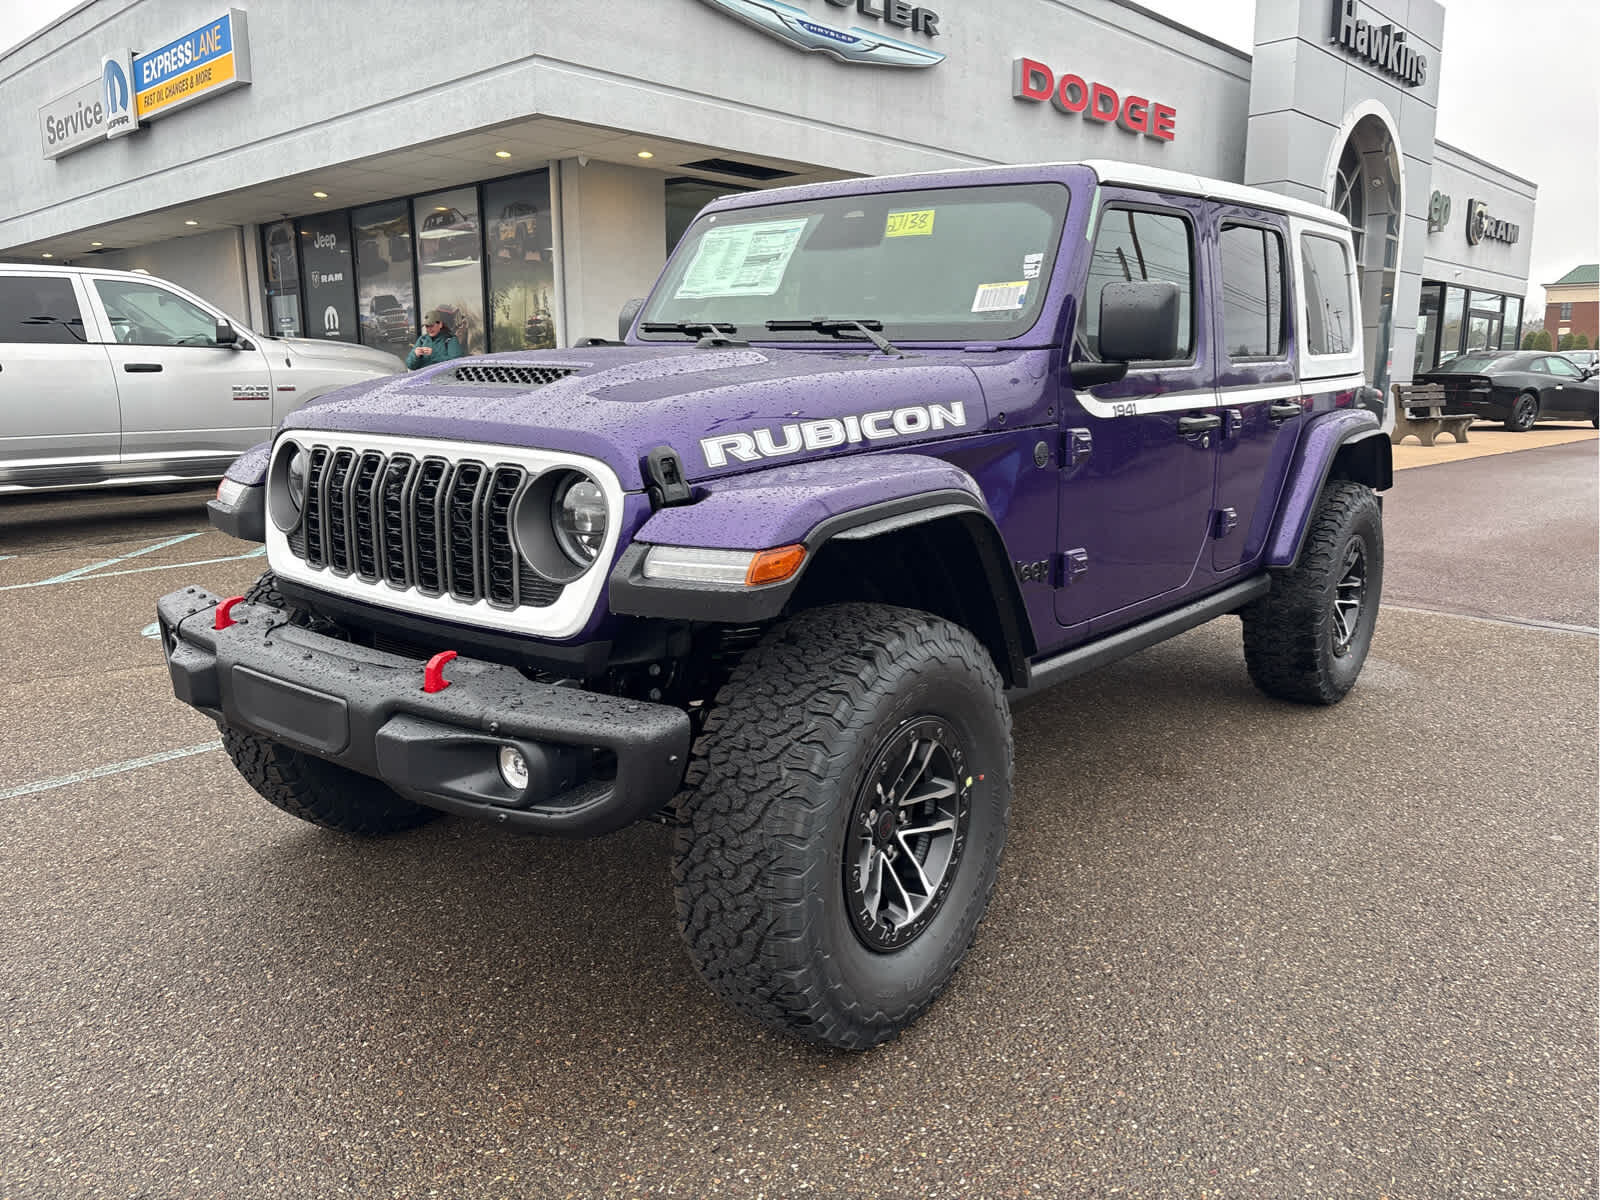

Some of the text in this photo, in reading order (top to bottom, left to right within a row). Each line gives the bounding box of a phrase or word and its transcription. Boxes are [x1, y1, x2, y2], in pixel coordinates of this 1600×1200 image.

[803, 23, 854, 42] CHRYSLER
[824, 0, 940, 37] LER
[1334, 0, 1427, 87] Hawkins
[144, 67, 213, 107] FAST OIL CHANGES & MORE
[1014, 57, 1176, 143] DODGE
[46, 101, 103, 145] Service
[887, 213, 929, 232] 27138
[1486, 215, 1520, 244] RAM
[314, 232, 337, 250] Jeep
[320, 273, 343, 283] RAM
[1112, 403, 1136, 417] 1941
[700, 401, 967, 468] RUBICON
